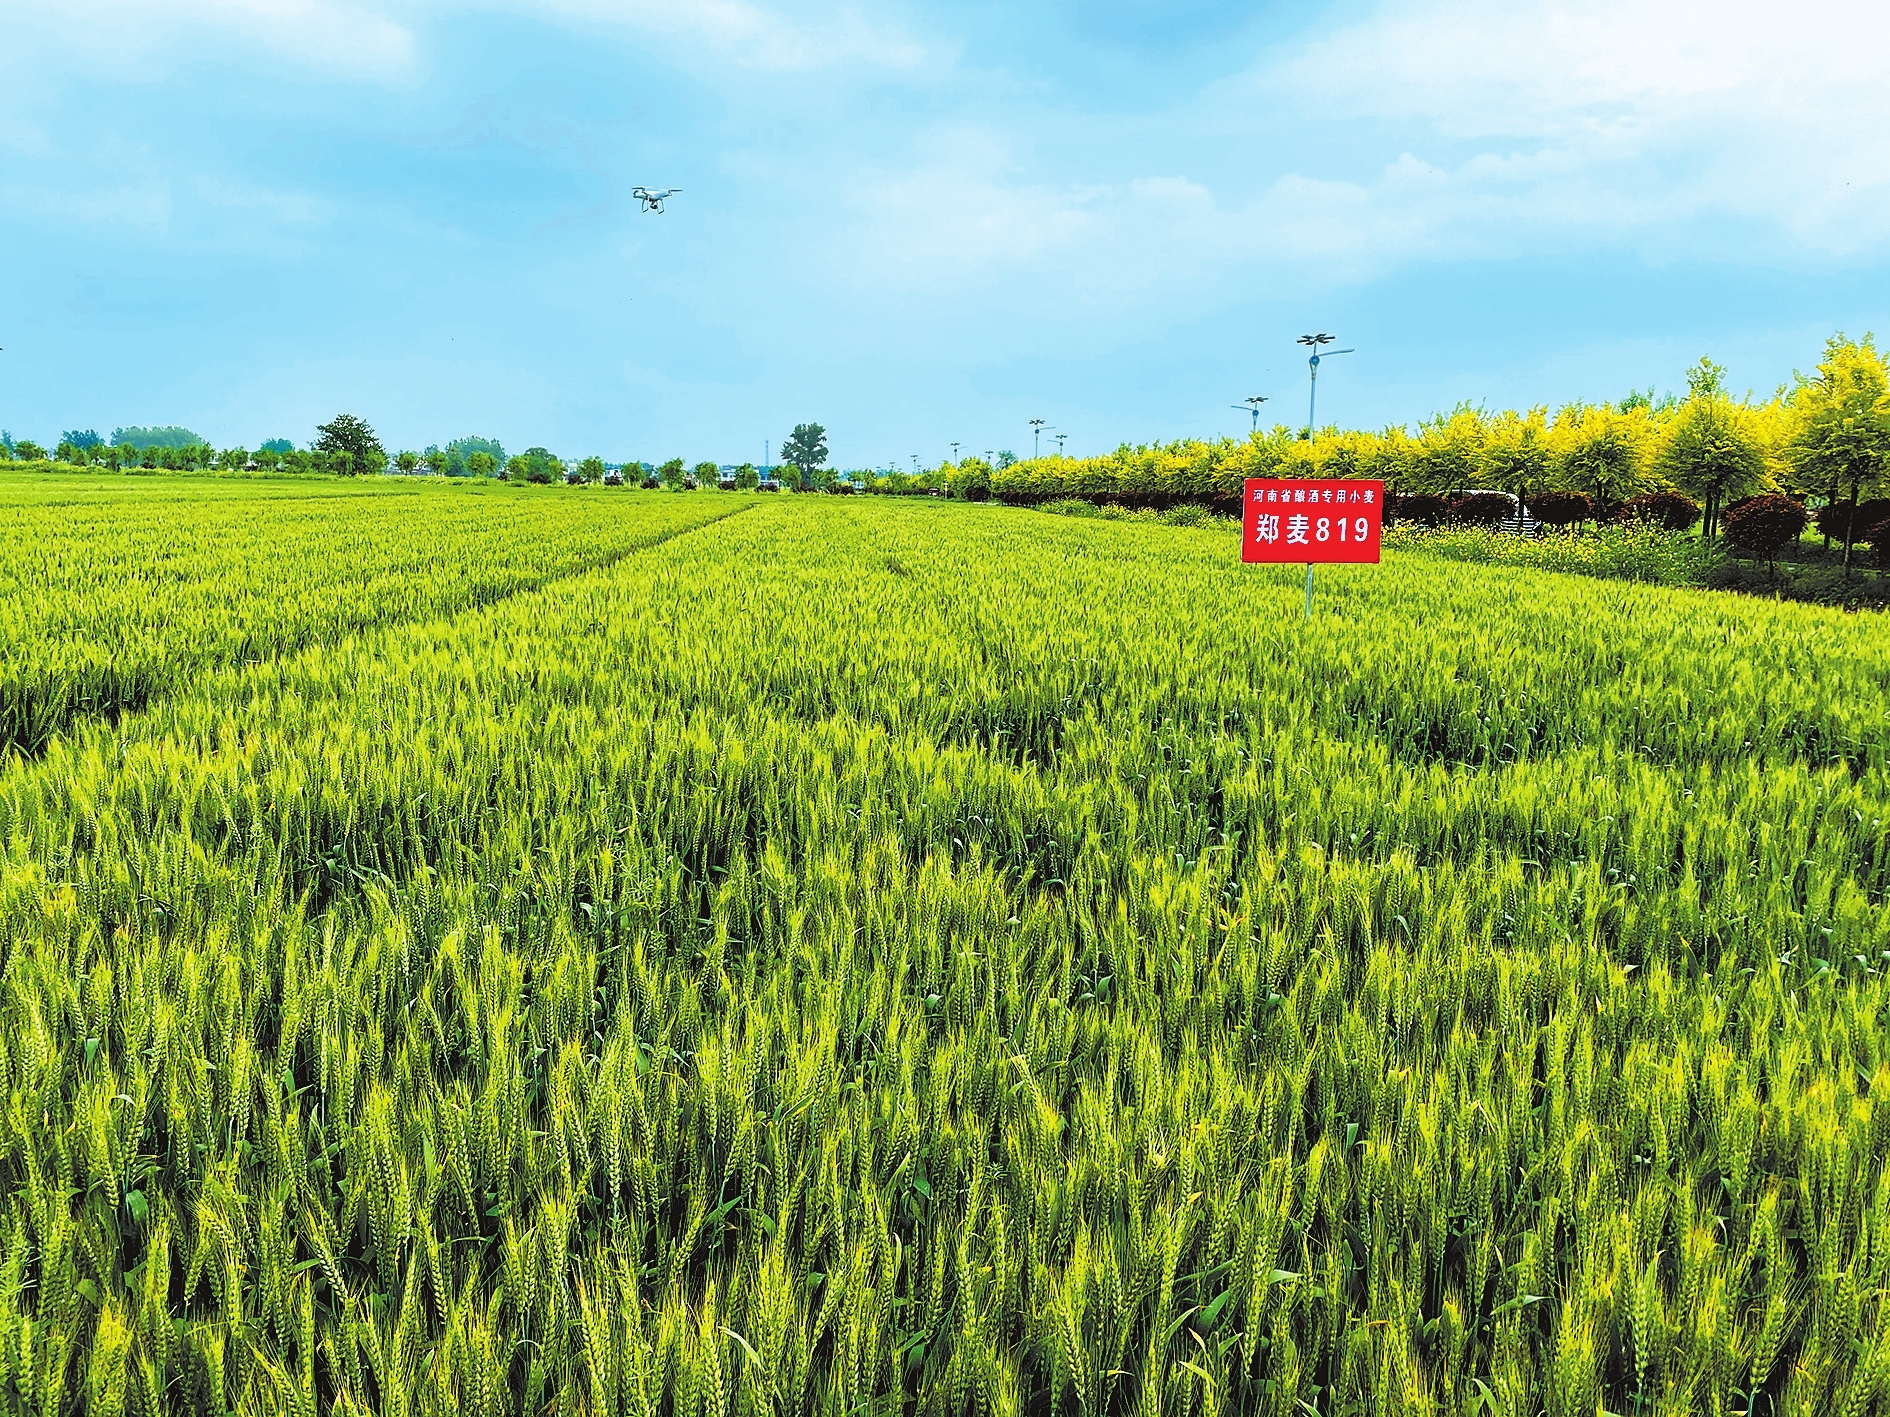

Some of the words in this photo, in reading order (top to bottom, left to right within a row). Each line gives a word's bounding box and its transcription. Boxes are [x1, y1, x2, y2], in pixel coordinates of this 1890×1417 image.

[1252, 488, 1375, 504] 河南省酿酒专用小麦
[1255, 513, 1369, 545] 郑麦819
